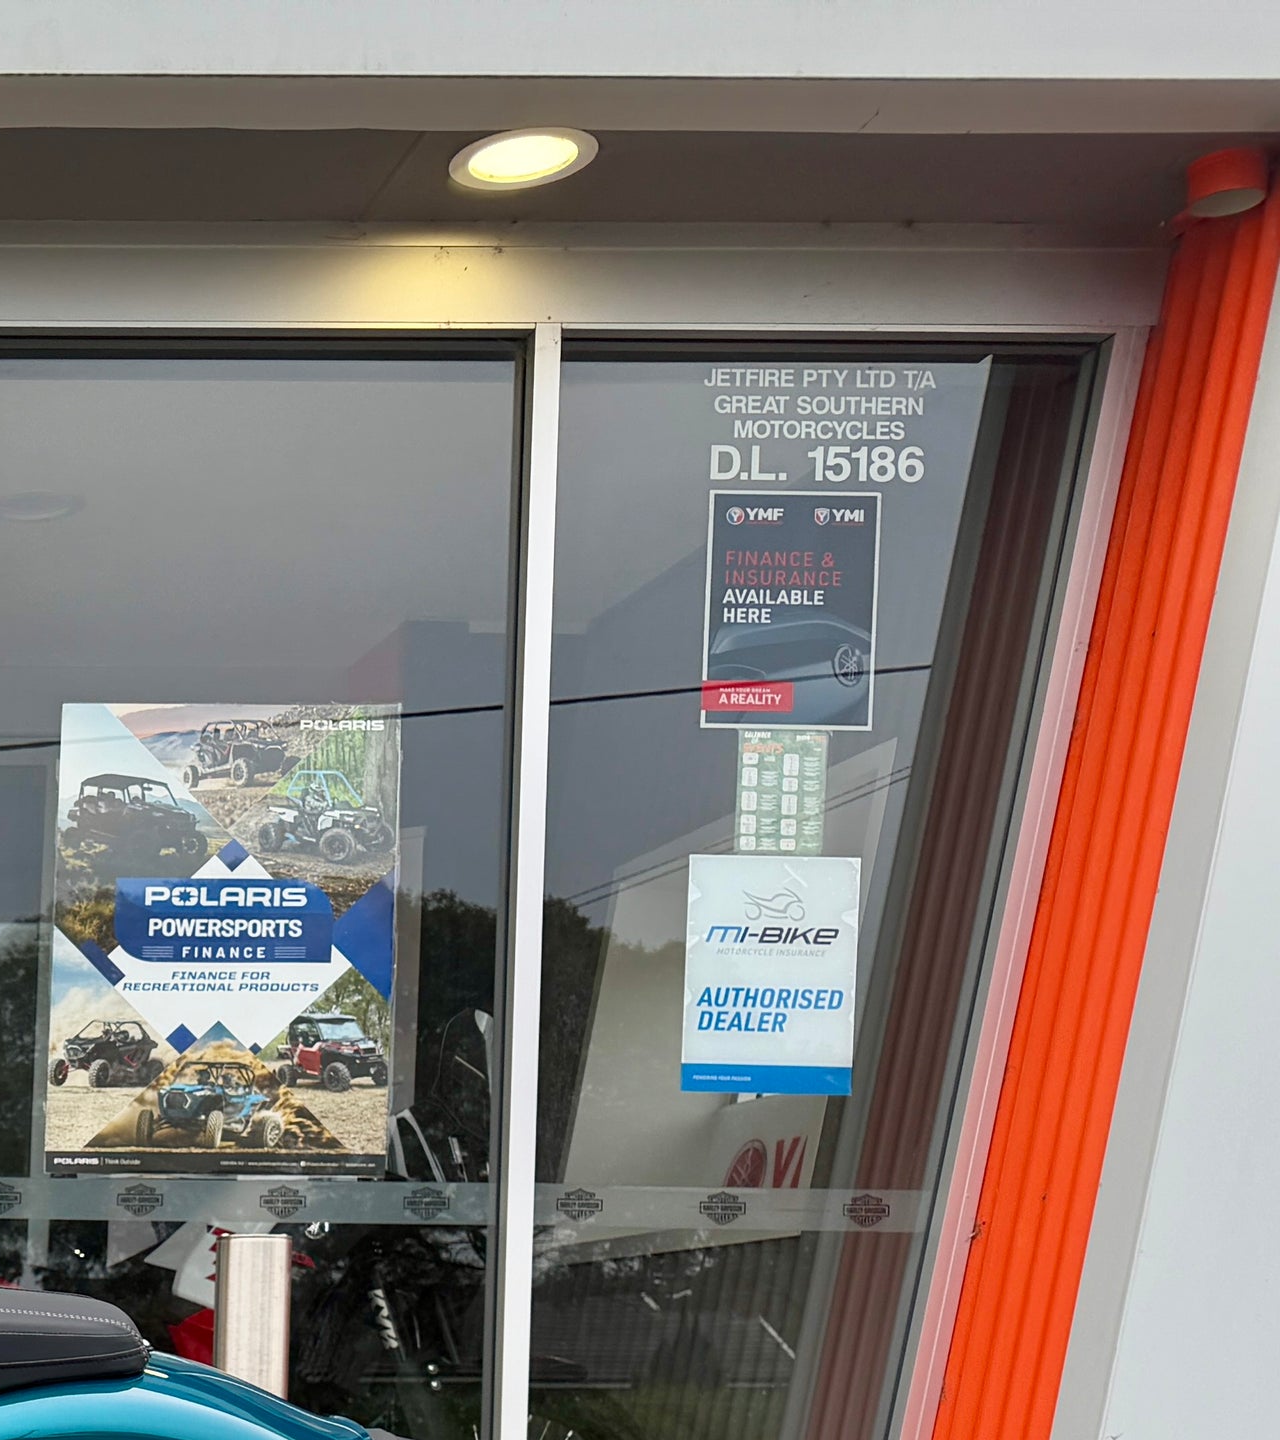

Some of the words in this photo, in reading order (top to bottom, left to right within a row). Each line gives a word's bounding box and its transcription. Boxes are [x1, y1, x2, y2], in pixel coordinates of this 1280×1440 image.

[703, 368, 795, 388] JETFIRE
[802, 369, 848, 388] PTY
[856, 370, 896, 388] LTD
[903, 370, 937, 391] T/A
[713, 395, 790, 414] GREAT
[796, 396, 924, 415] SOUTHERN
[733, 420, 906, 440] MOTORCYCLES
[709, 445, 787, 481] D.L.
[807, 446, 925, 483] 15186
[746, 507, 784, 521] YMF
[832, 509, 865, 522] YMI
[725, 550, 814, 567] FINANCE
[821, 552, 835, 568] &
[725, 570, 842, 586] INSURANCE
[722, 588, 825, 605] AVAILABLE
[723, 607, 771, 623] HERE
[718, 693, 728, 704] A
[730, 693, 781, 705] REALITY
[300, 719, 385, 731] POLARIS
[144, 886, 308, 908] POLARIS
[148, 918, 303, 938] POWERSPORTS
[181, 946, 267, 959] FINANCE
[716, 947, 773, 956] MOTORCYCLE
[776, 948, 827, 957] INSURANCE
[171, 971, 238, 980] FINANCE
[241, 971, 271, 980] FOR
[122, 982, 235, 992] RECREATIONAL
[239, 983, 319, 992] PRODUCTS
[696, 986, 844, 1010] AUTHORISED
[697, 1010, 788, 1033] DEALER
[53, 1157, 99, 1165] POLARIS
